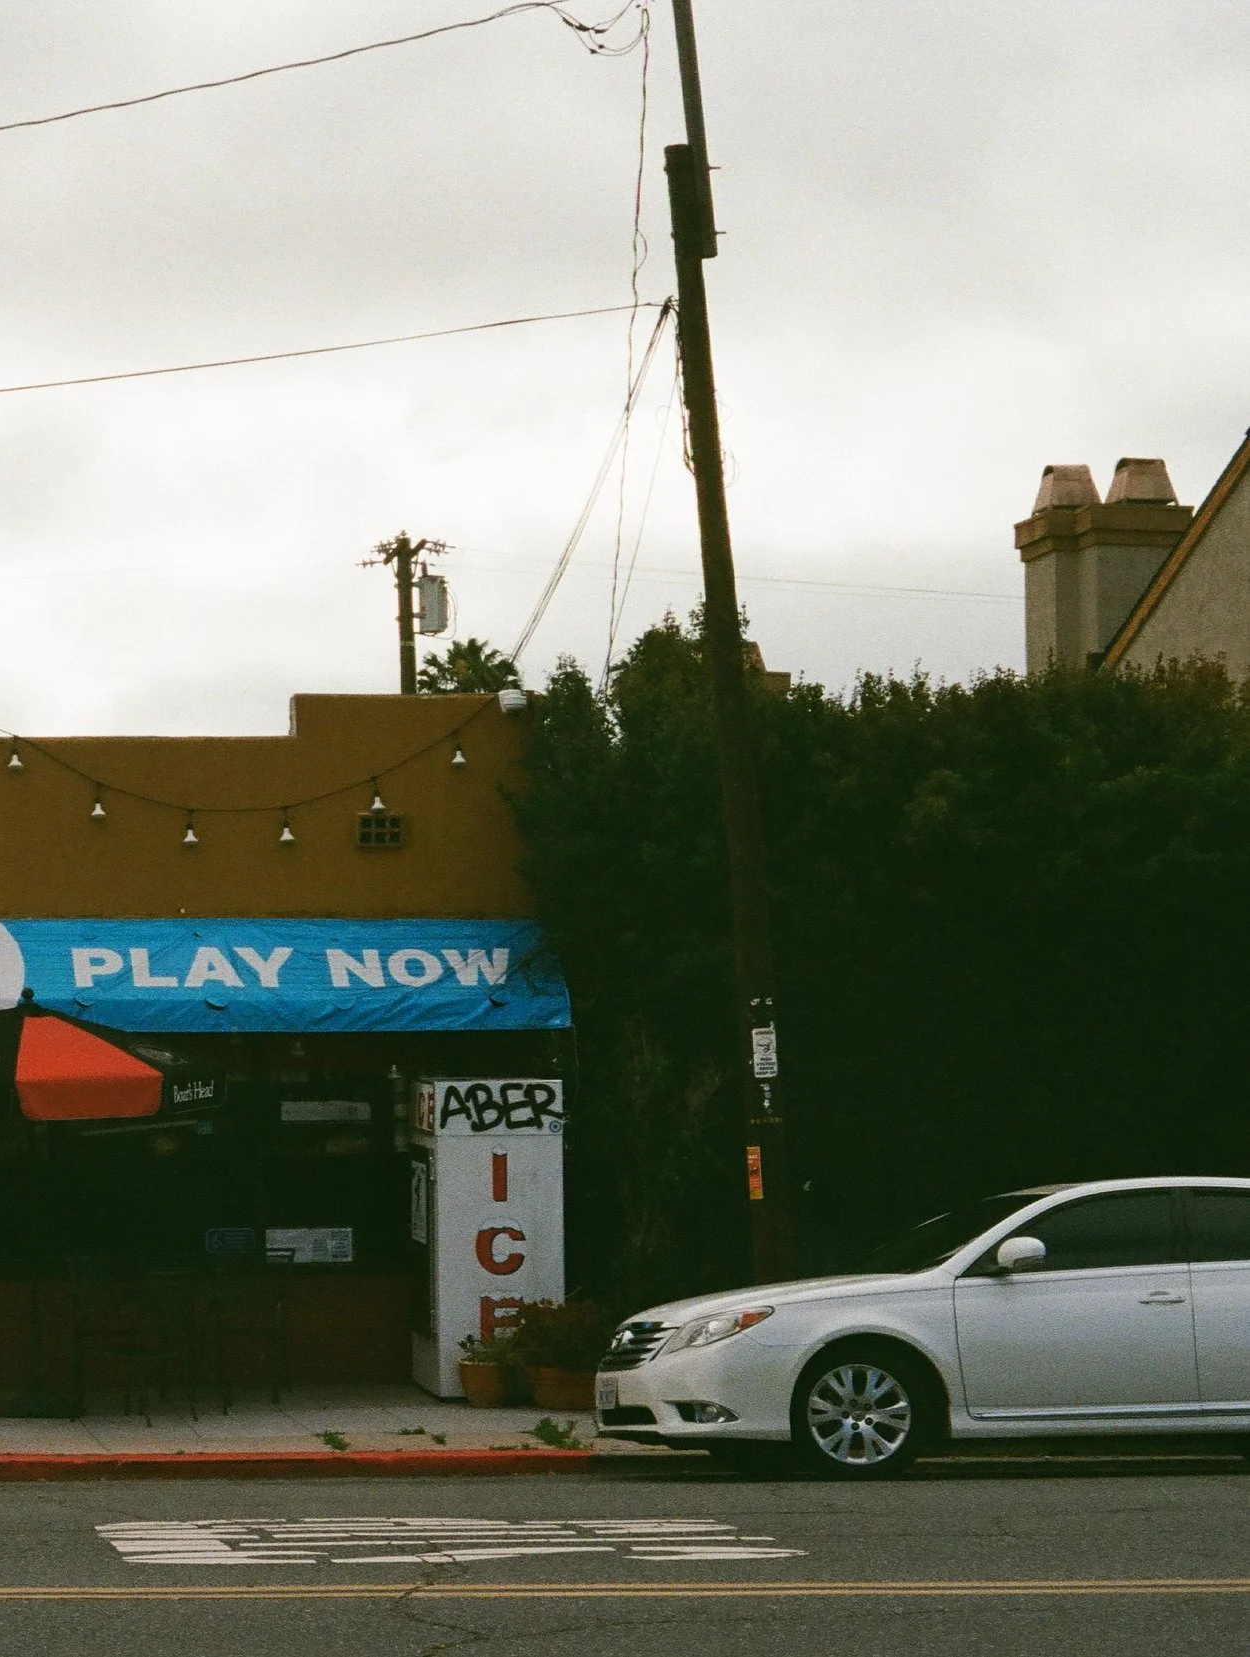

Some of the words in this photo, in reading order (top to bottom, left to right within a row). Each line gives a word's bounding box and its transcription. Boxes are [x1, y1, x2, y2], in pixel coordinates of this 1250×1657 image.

[70, 946, 294, 988] PLAY
[325, 947, 510, 988] NOW
[173, 1083, 193, 1104] Boar's
[194, 1079, 215, 1101] Head
